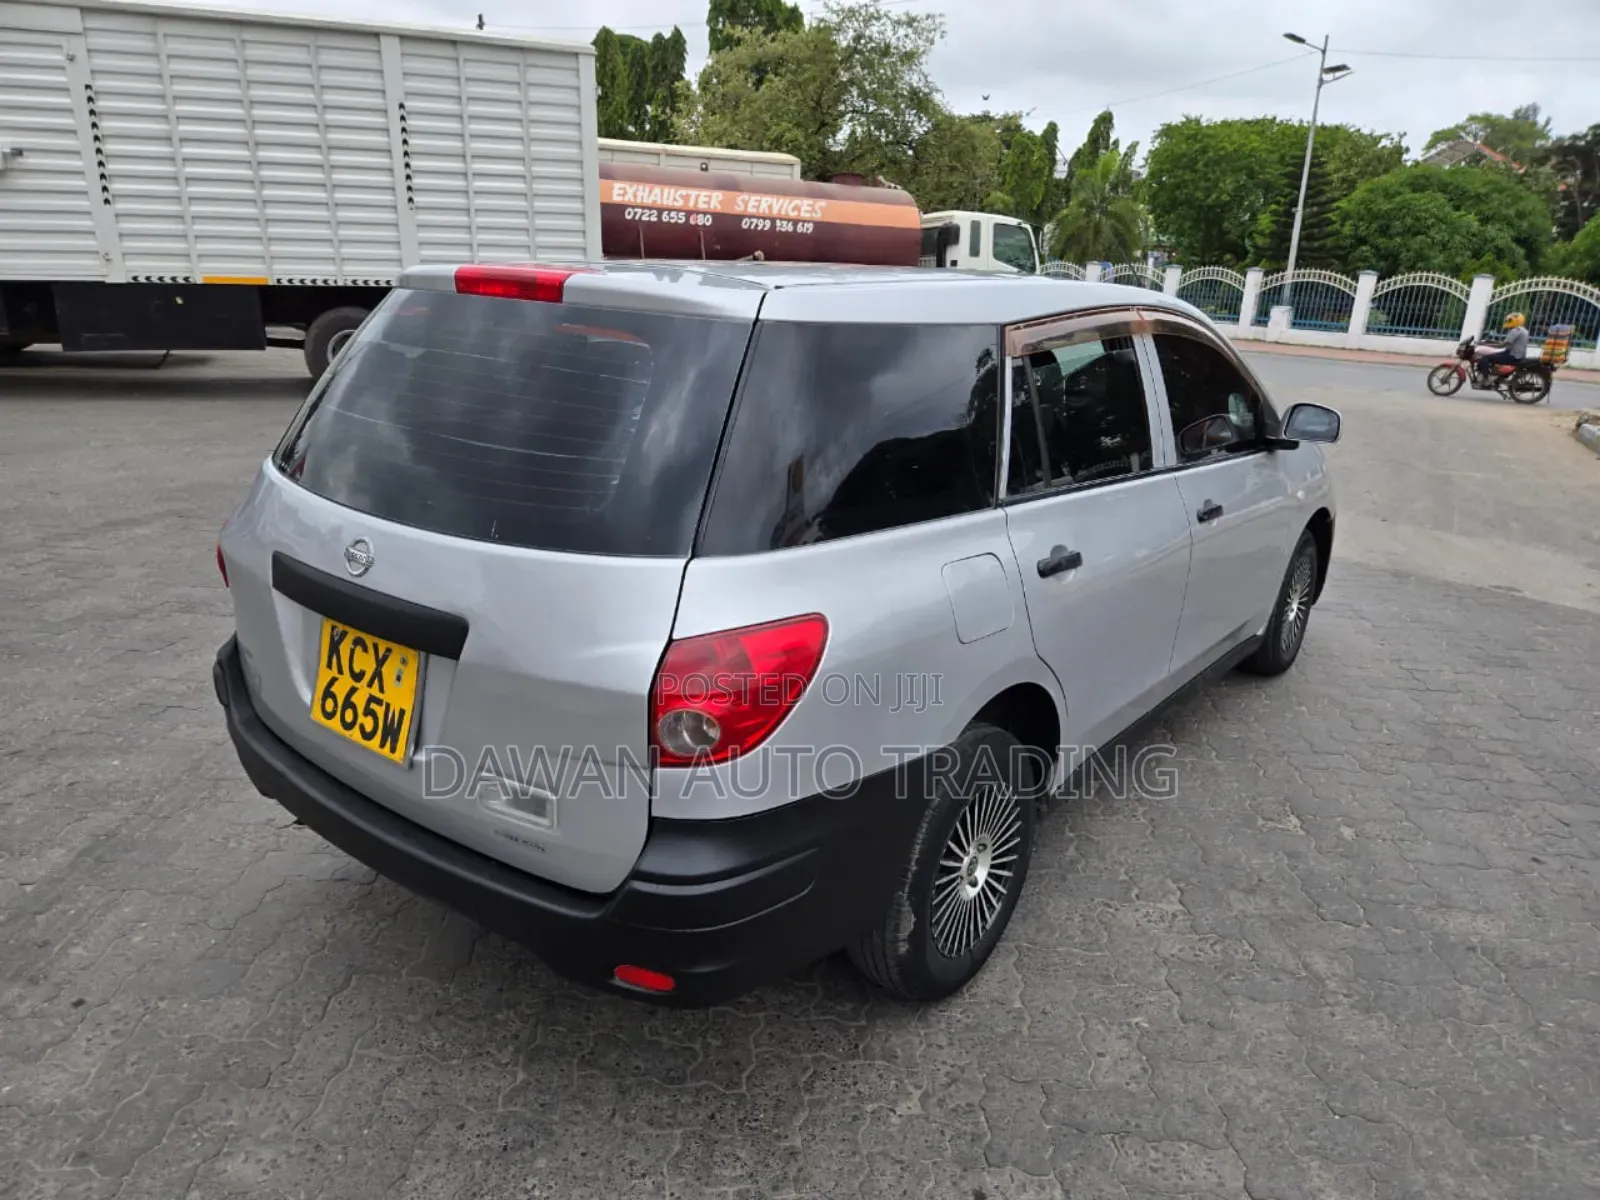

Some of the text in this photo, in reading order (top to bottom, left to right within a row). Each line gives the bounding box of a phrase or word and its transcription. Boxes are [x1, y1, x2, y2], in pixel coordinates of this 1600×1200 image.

[612, 182, 827, 218] EXHAUSTER SERVICES
[624, 206, 659, 222] 0722
[661, 209, 686, 224] 655
[741, 217, 771, 231] 0799
[326, 624, 392, 694] KCX
[320, 676, 406, 754] 665W
